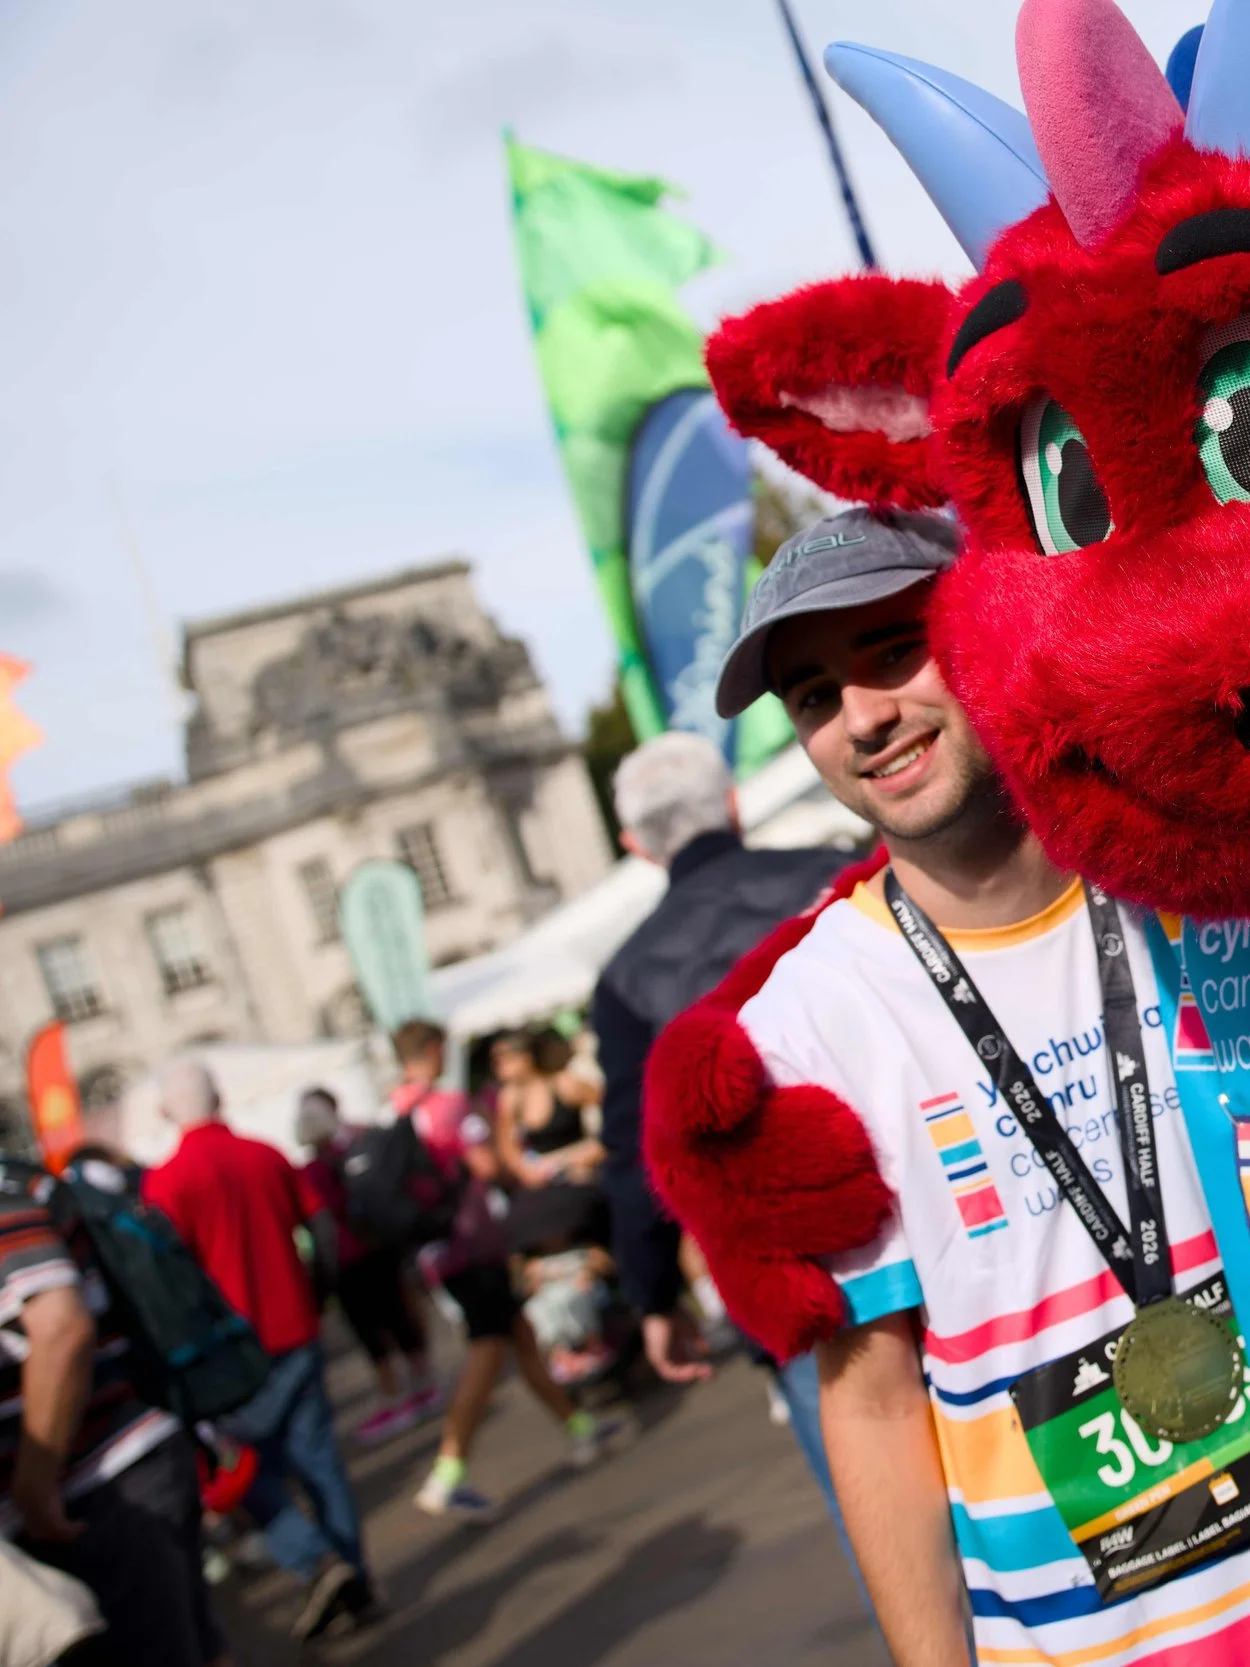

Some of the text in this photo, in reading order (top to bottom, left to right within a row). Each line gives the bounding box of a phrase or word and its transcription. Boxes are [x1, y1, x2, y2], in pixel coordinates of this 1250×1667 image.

[1009, 1081, 1042, 1123] 2026
[1130, 1083, 1151, 1149] CARDIFF
[1045, 1150, 1076, 1186] HALF
[1138, 1148, 1156, 1189] HALF
[1067, 1186, 1109, 1240] CARDIFF
[1140, 1219, 1160, 1265] 2026
[1185, 1281, 1224, 1309] ALF
[1108, 1553, 1156, 1580] BAGGAGE
[1155, 1541, 1188, 1562] LABEL
[1192, 1524, 1223, 1546] LABEL
